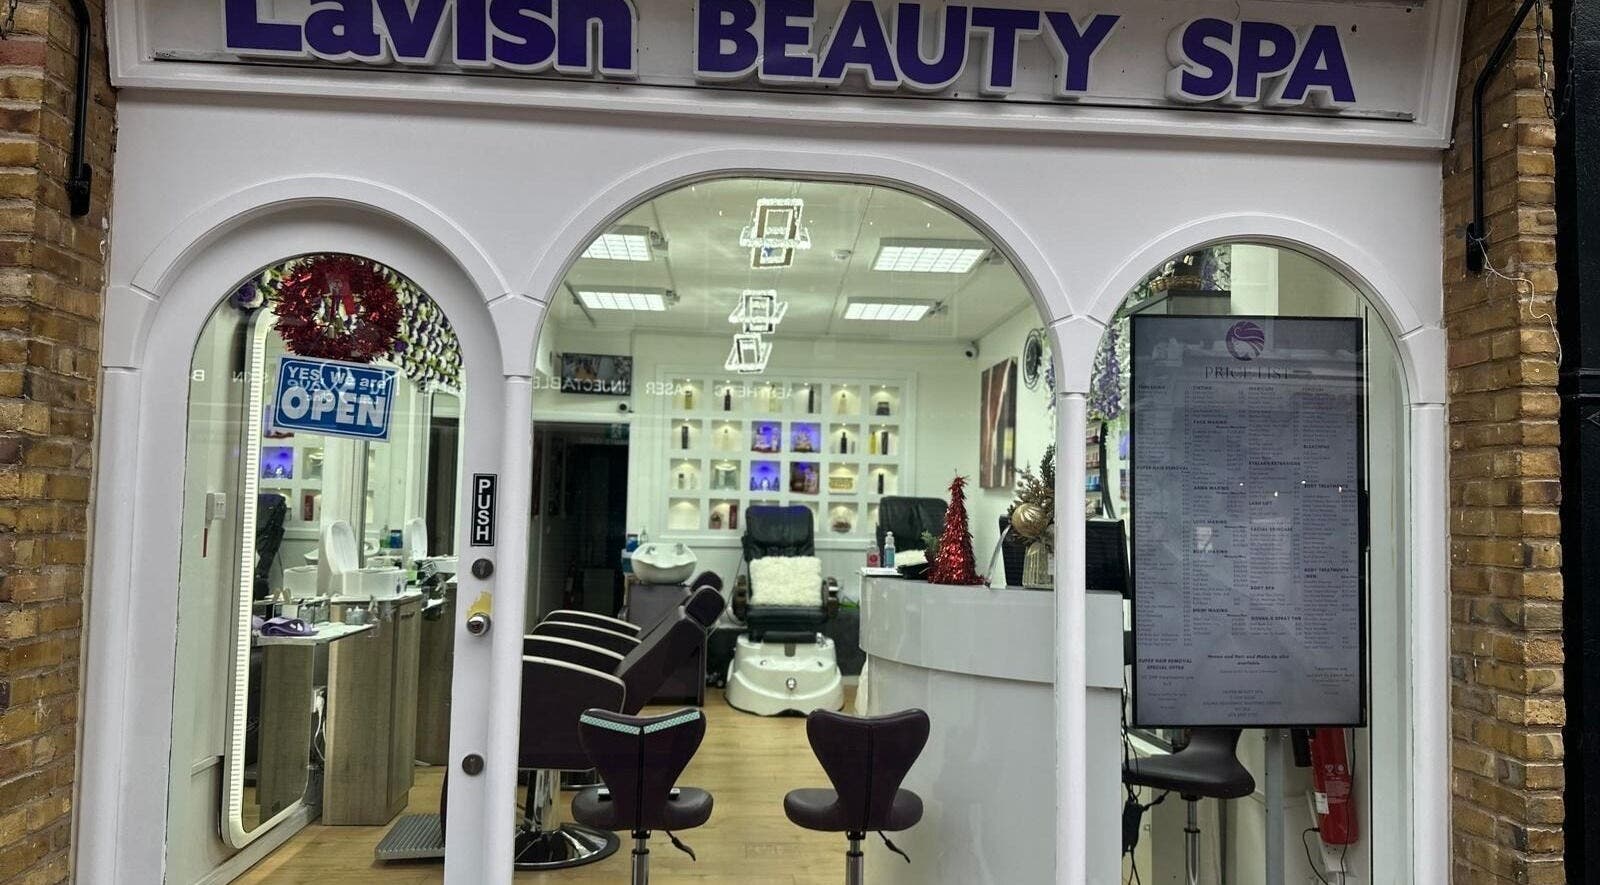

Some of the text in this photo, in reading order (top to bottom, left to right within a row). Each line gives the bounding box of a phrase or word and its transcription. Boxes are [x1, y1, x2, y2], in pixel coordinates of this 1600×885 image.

[698, 0, 1119, 91] BEAUTY
[1181, 18, 1356, 102] SPA
[1258, 366, 1290, 379] LIST
[281, 385, 386, 428] OPEN
[477, 479, 491, 541] PUSH
